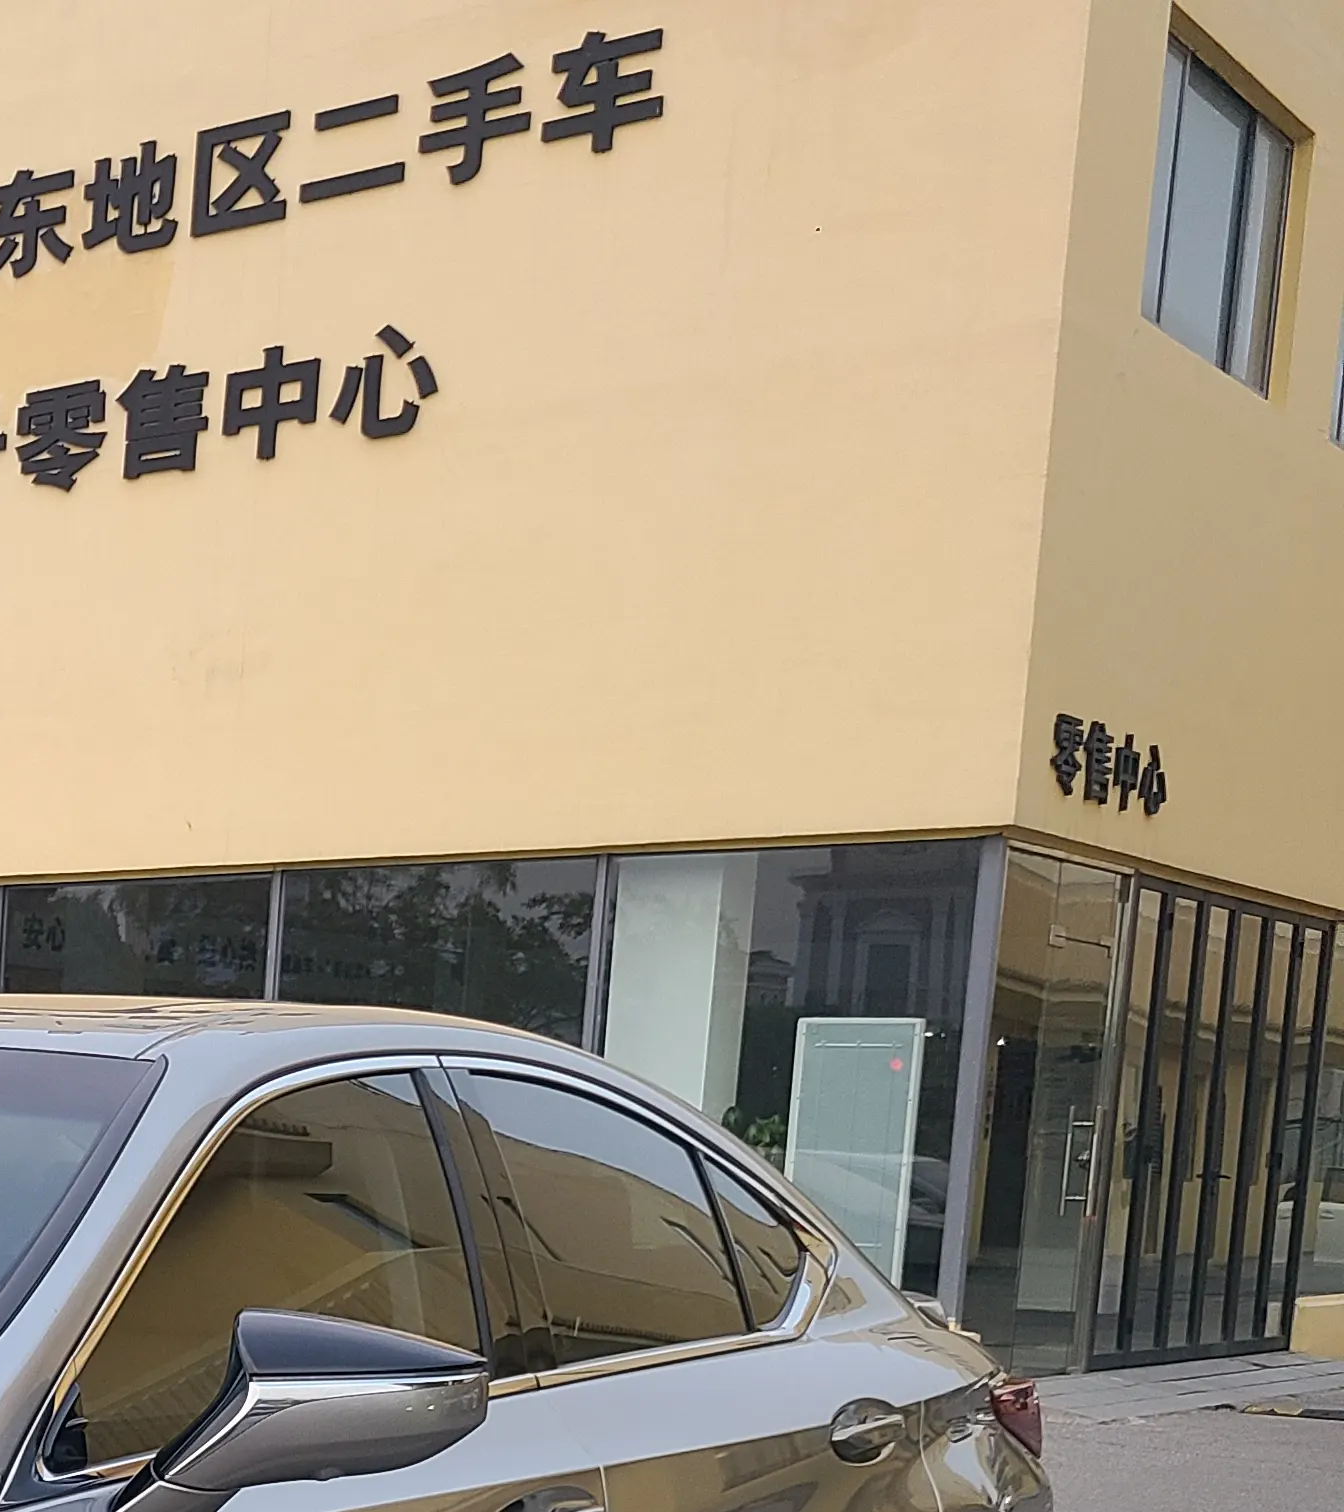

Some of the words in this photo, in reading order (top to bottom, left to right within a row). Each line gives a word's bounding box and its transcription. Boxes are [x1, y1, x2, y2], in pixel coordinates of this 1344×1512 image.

[1050, 713, 1168, 817] 零售中心
[22, 912, 66, 952] 安心
